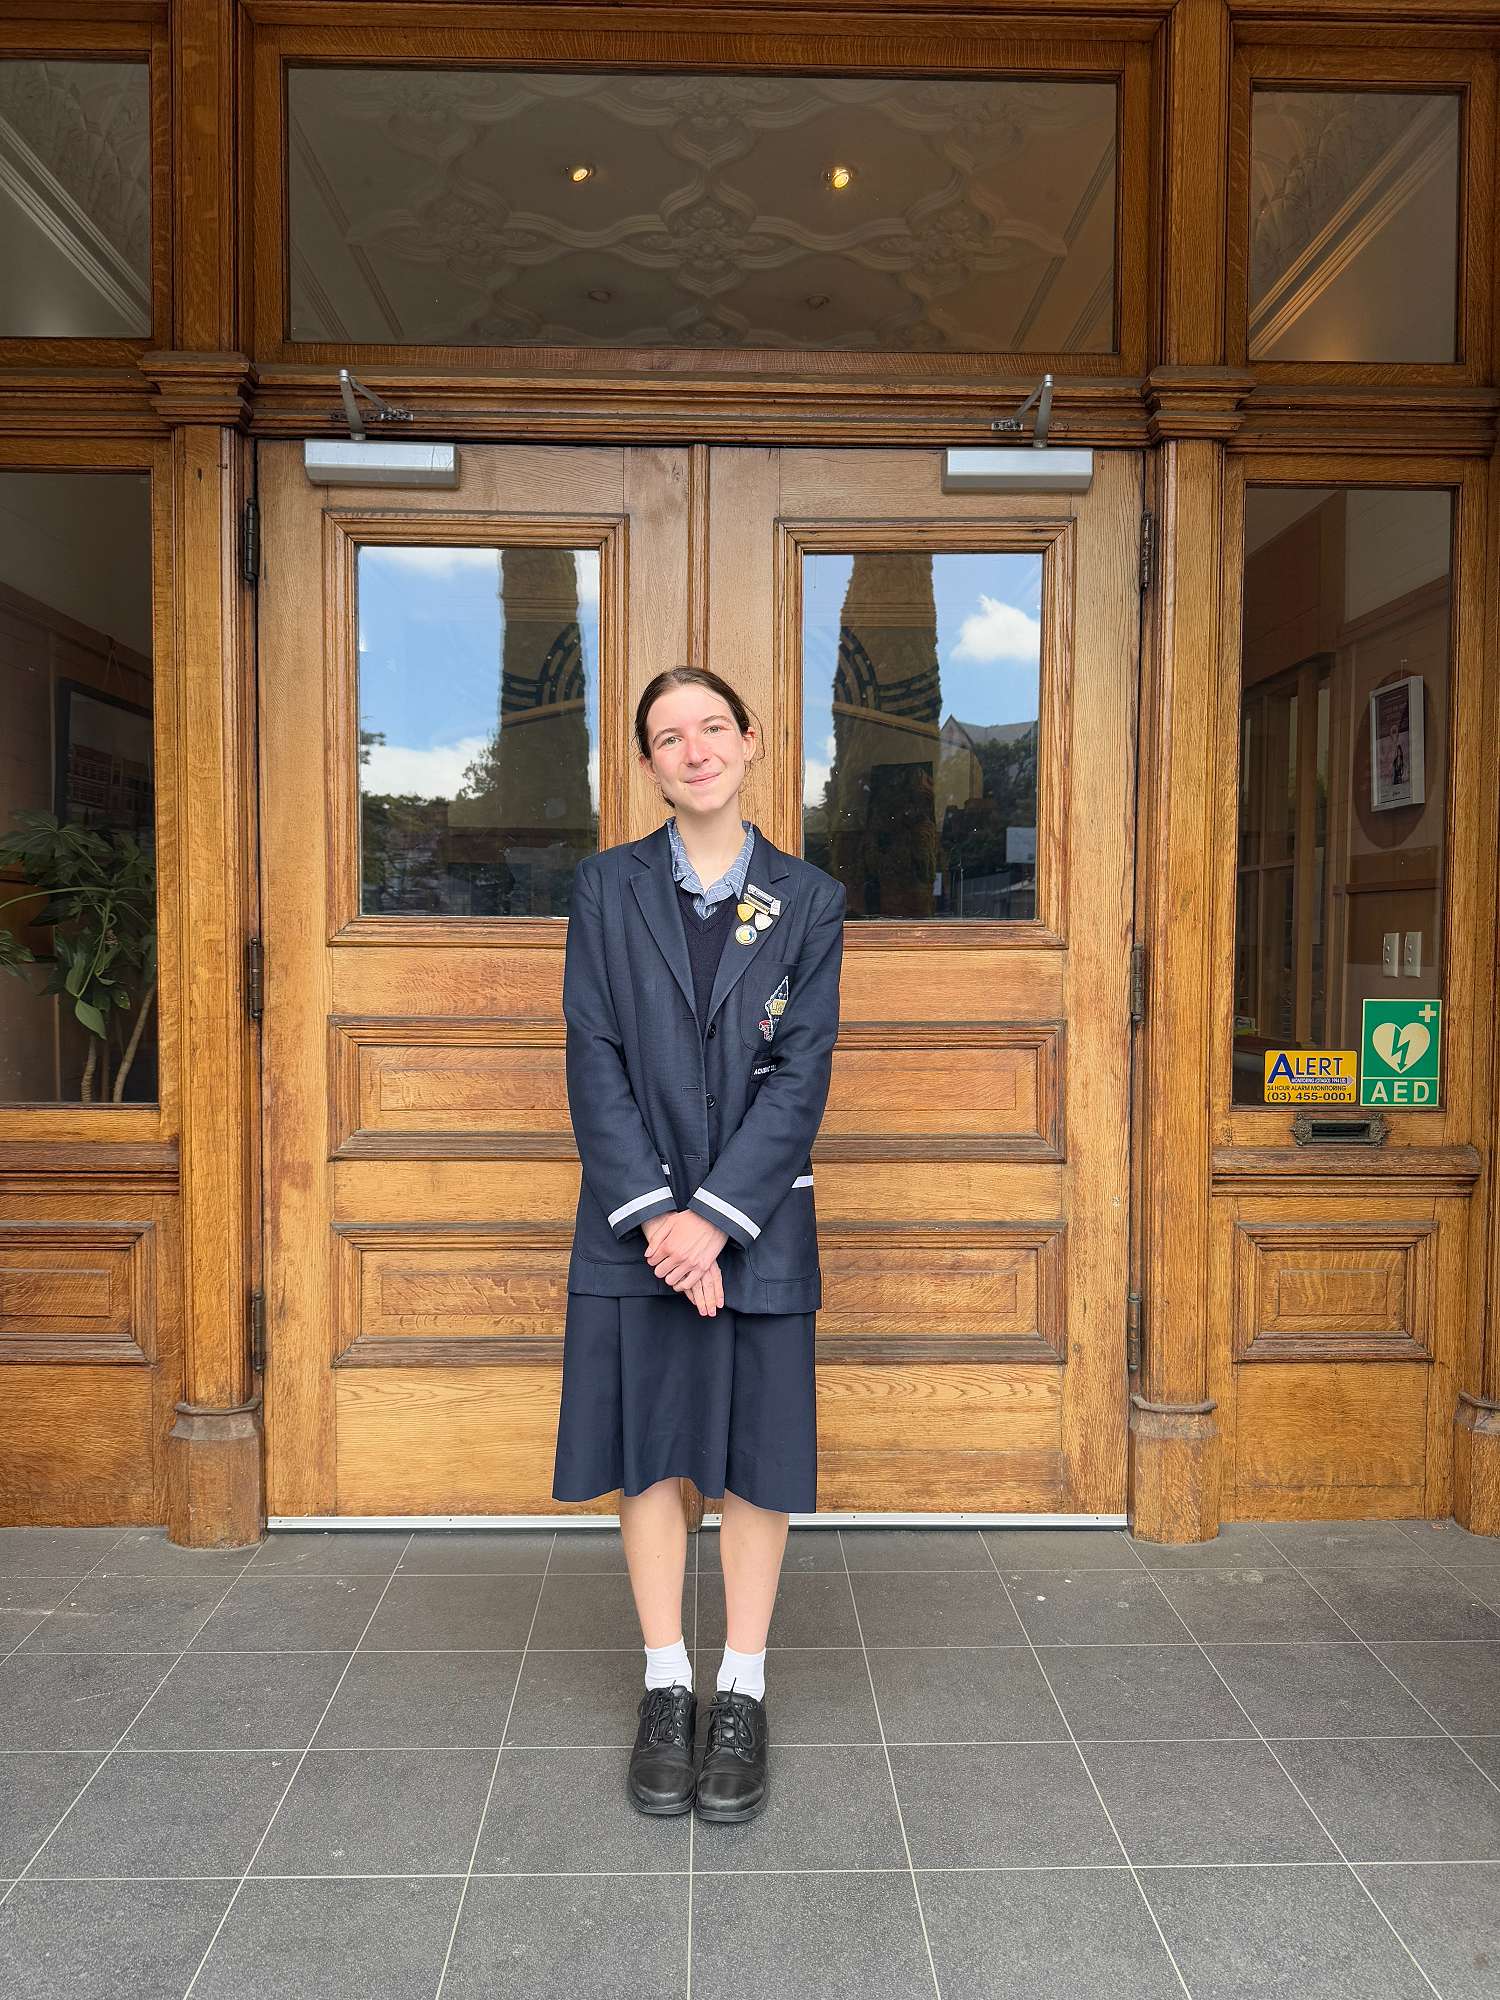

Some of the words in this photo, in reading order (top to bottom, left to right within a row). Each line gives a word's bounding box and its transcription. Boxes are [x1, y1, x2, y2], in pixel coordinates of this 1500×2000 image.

[1267, 1053, 1343, 1083] ALERT
[1267, 1092, 1292, 1102] (03)
[1296, 1092, 1352, 1101] 455-0001
[1370, 1081, 1430, 1103] AED
